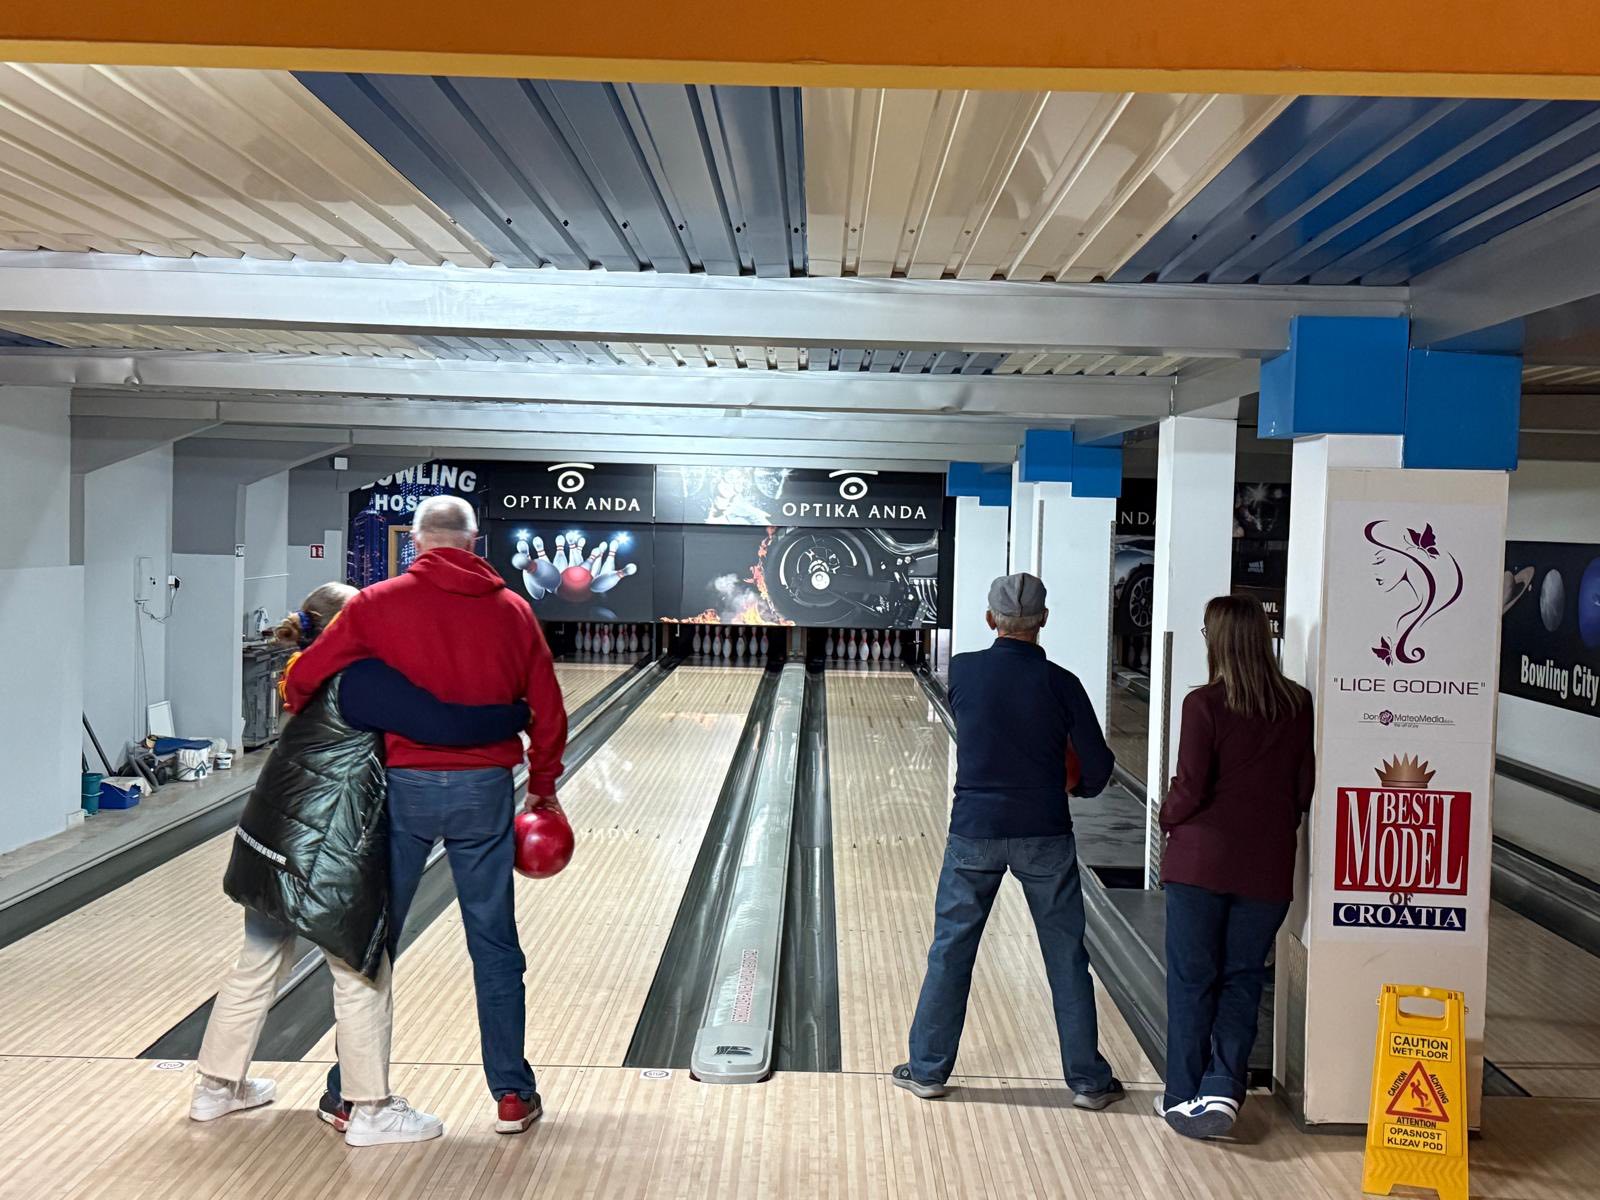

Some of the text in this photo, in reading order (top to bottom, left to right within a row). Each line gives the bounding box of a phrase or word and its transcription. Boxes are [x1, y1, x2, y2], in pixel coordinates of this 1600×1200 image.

[361, 464, 477, 492] WLING
[503, 495, 641, 512] OPTIKA ANDA
[782, 502, 927, 520] OPTIKA ANDA
[1116, 511, 1156, 526] ND
[1333, 677, 1486, 696] "LICE GODINE"
[1520, 654, 1600, 707] Bowling City
[1381, 792, 1440, 826] BEST
[1342, 791, 1463, 890] MODEL
[1389, 892, 1414, 906] OF
[1338, 904, 1463, 928] CROATIA
[1393, 1035, 1449, 1051] CAUTION
[1392, 1046, 1449, 1060] WET FLOOR
[1387, 1070, 1408, 1097] CAUTION
[1429, 1073, 1449, 1104] ACHTUNG
[1396, 1116, 1437, 1129] ATTENTION
[1389, 1127, 1442, 1141] OPASNOST
[1387, 1136, 1443, 1151] KLIZAV POD
